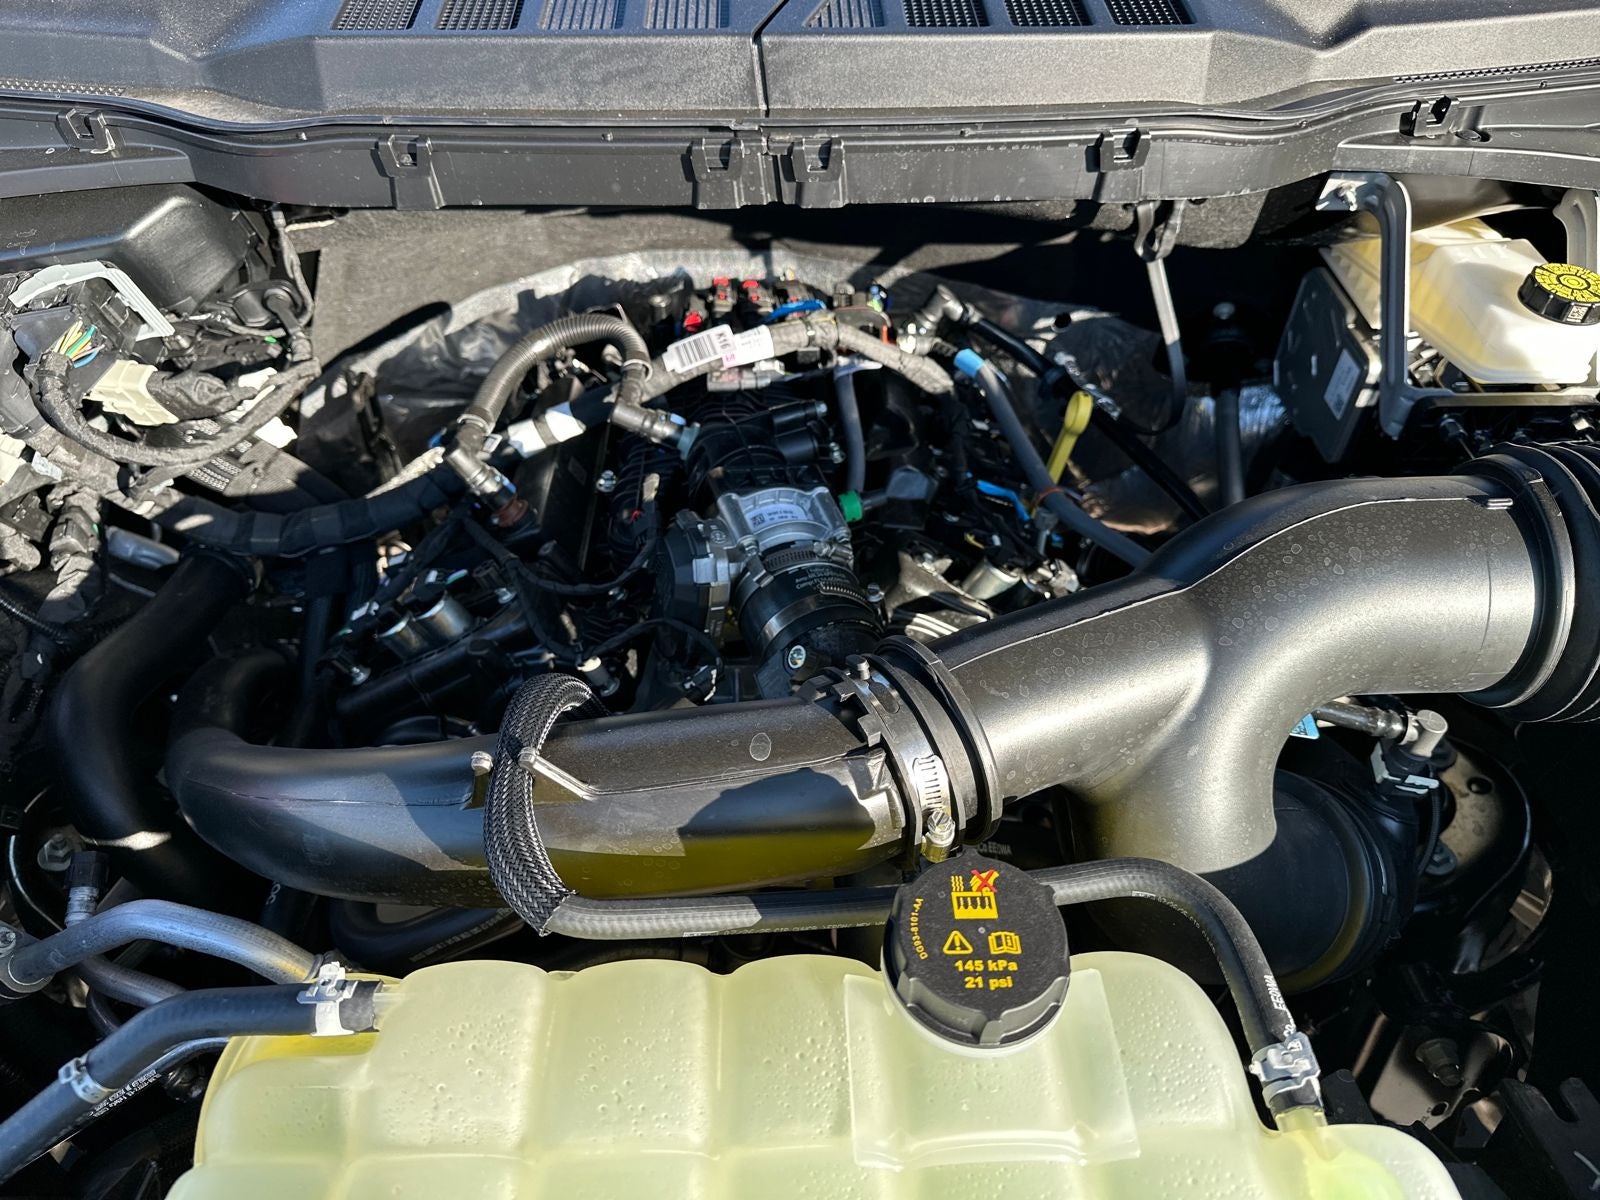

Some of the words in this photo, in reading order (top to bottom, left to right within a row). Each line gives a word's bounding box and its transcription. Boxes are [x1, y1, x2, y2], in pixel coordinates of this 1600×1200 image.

[954, 959, 984, 972] 145
[987, 959, 1018, 972] kPa
[964, 976, 984, 989] 21
[988, 975, 1013, 991] psi
